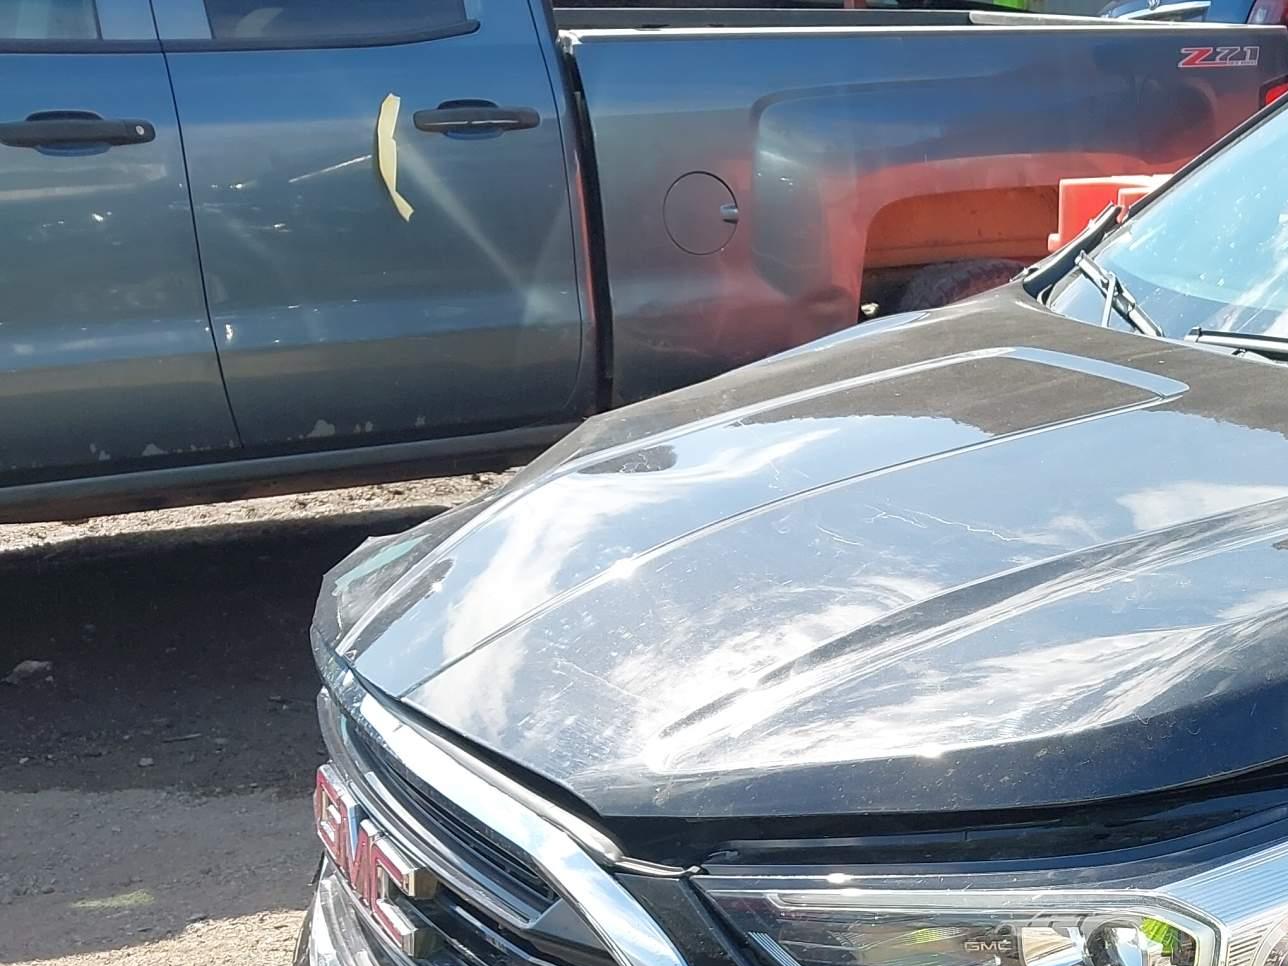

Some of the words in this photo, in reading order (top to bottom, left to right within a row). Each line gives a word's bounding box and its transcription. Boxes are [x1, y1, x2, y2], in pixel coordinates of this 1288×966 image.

[1177, 46, 1260, 68] Z71
[313, 762, 430, 959] GMC
[963, 939, 1013, 952] GMC
